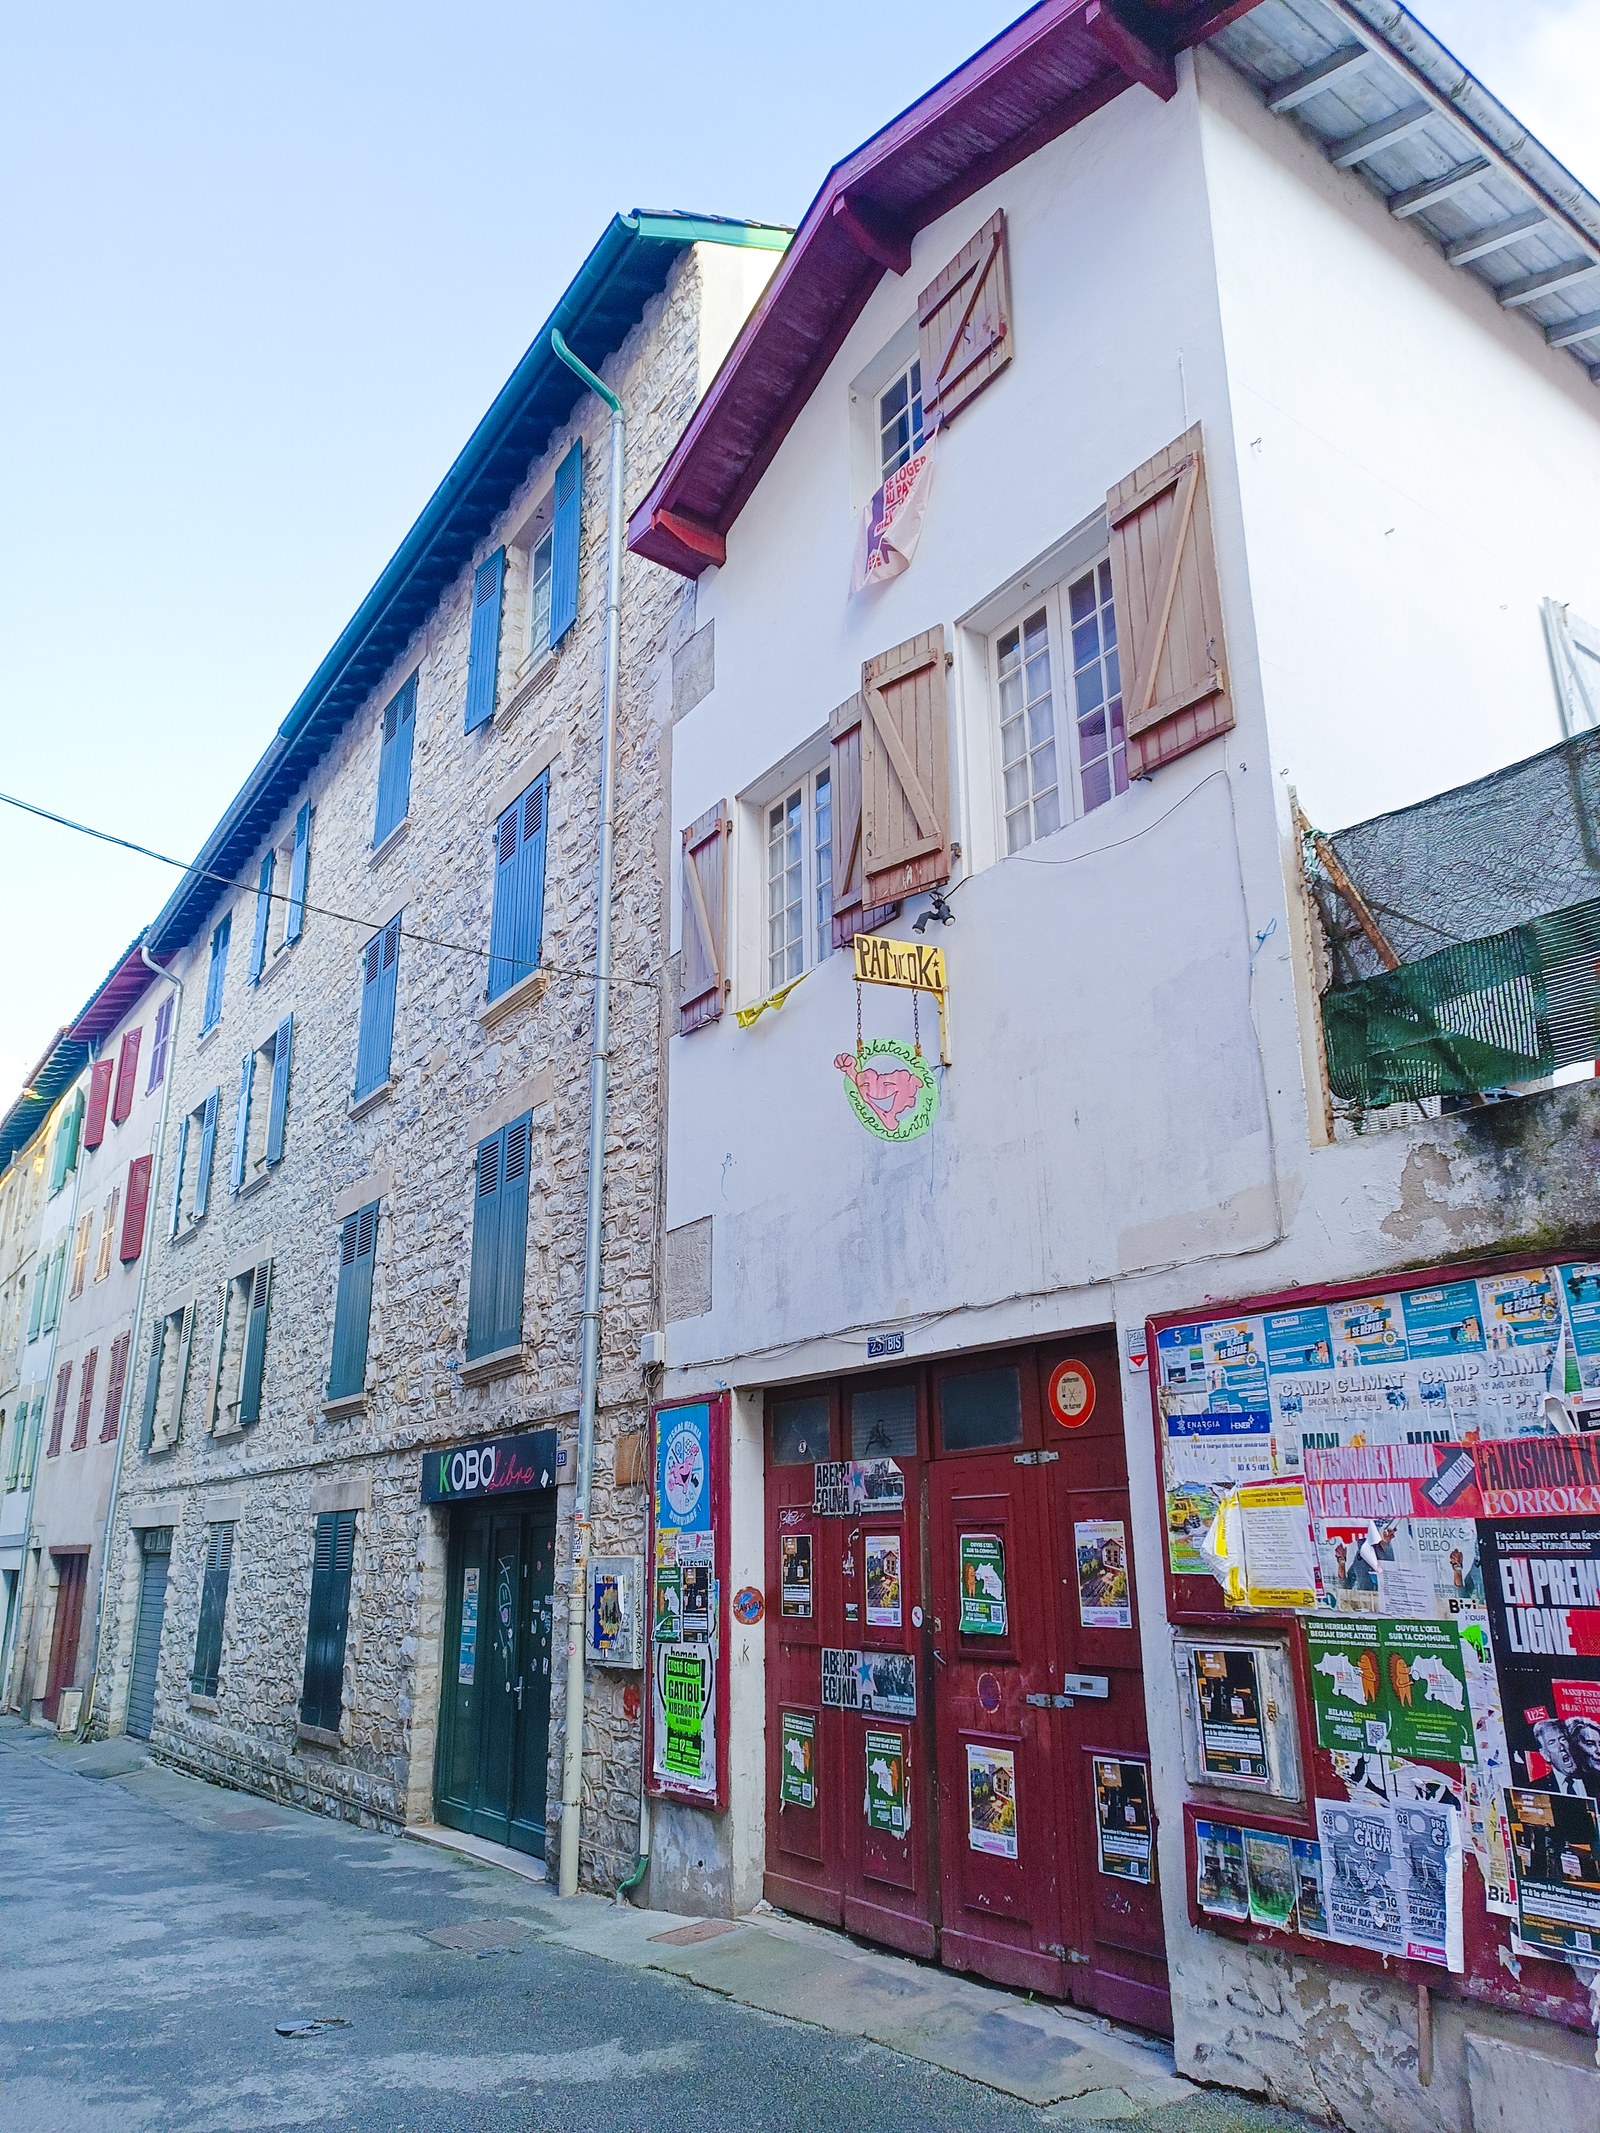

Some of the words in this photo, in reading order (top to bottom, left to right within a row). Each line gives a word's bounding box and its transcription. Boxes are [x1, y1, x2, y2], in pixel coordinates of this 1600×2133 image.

[885, 489, 895, 507] AU
[1504, 1301, 1514, 1313] SE
[1174, 1330, 1182, 1344] 5
[1351, 1327, 1360, 1337] SE
[887, 1336, 901, 1351] BIS
[1219, 1350, 1228, 1359] SE
[1420, 1362, 1479, 1385] CAMP
[1280, 1380, 1330, 1398] CAMP
[1337, 1372, 1406, 1393] CLIMAT
[1187, 1420, 1220, 1428] ENARGIA
[1477, 1438, 1579, 1491] FAXISMOA
[1483, 1486, 1600, 1515] BORROKA
[1417, 1527, 1455, 1540] URRIAK
[1495, 1531, 1514, 1541] Face
[1521, 1530, 1530, 1540] la
[1531, 1532, 1560, 1543] guerre
[1560, 1532, 1569, 1540] et
[1570, 1532, 1580, 1540] au
[1418, 1539, 1451, 1551] BILBO
[1496, 1541, 1505, 1550] la
[1505, 1541, 1542, 1552] jeunesse
[1542, 1540, 1592, 1550] travailleuse
[1498, 1557, 1533, 1606] EN
[1308, 1621, 1324, 1630] ZURE
[1395, 1624, 1419, 1633] OUVRE
[1505, 1607, 1577, 1656] LIGNE
[1336, 1631, 1353, 1639] ERNE
[1388, 1632, 1403, 1640] SUR
[1413, 1633, 1451, 1642] COMMUNE
[668, 1679, 700, 1703] GATIBU
[1526, 1708, 1546, 1721] U25
[1322, 1815, 1334, 1825] 08
[1397, 1814, 1408, 1825] 08
[1353, 1827, 1393, 1854] GAUA
[1385, 1896, 1397, 1908] 10
